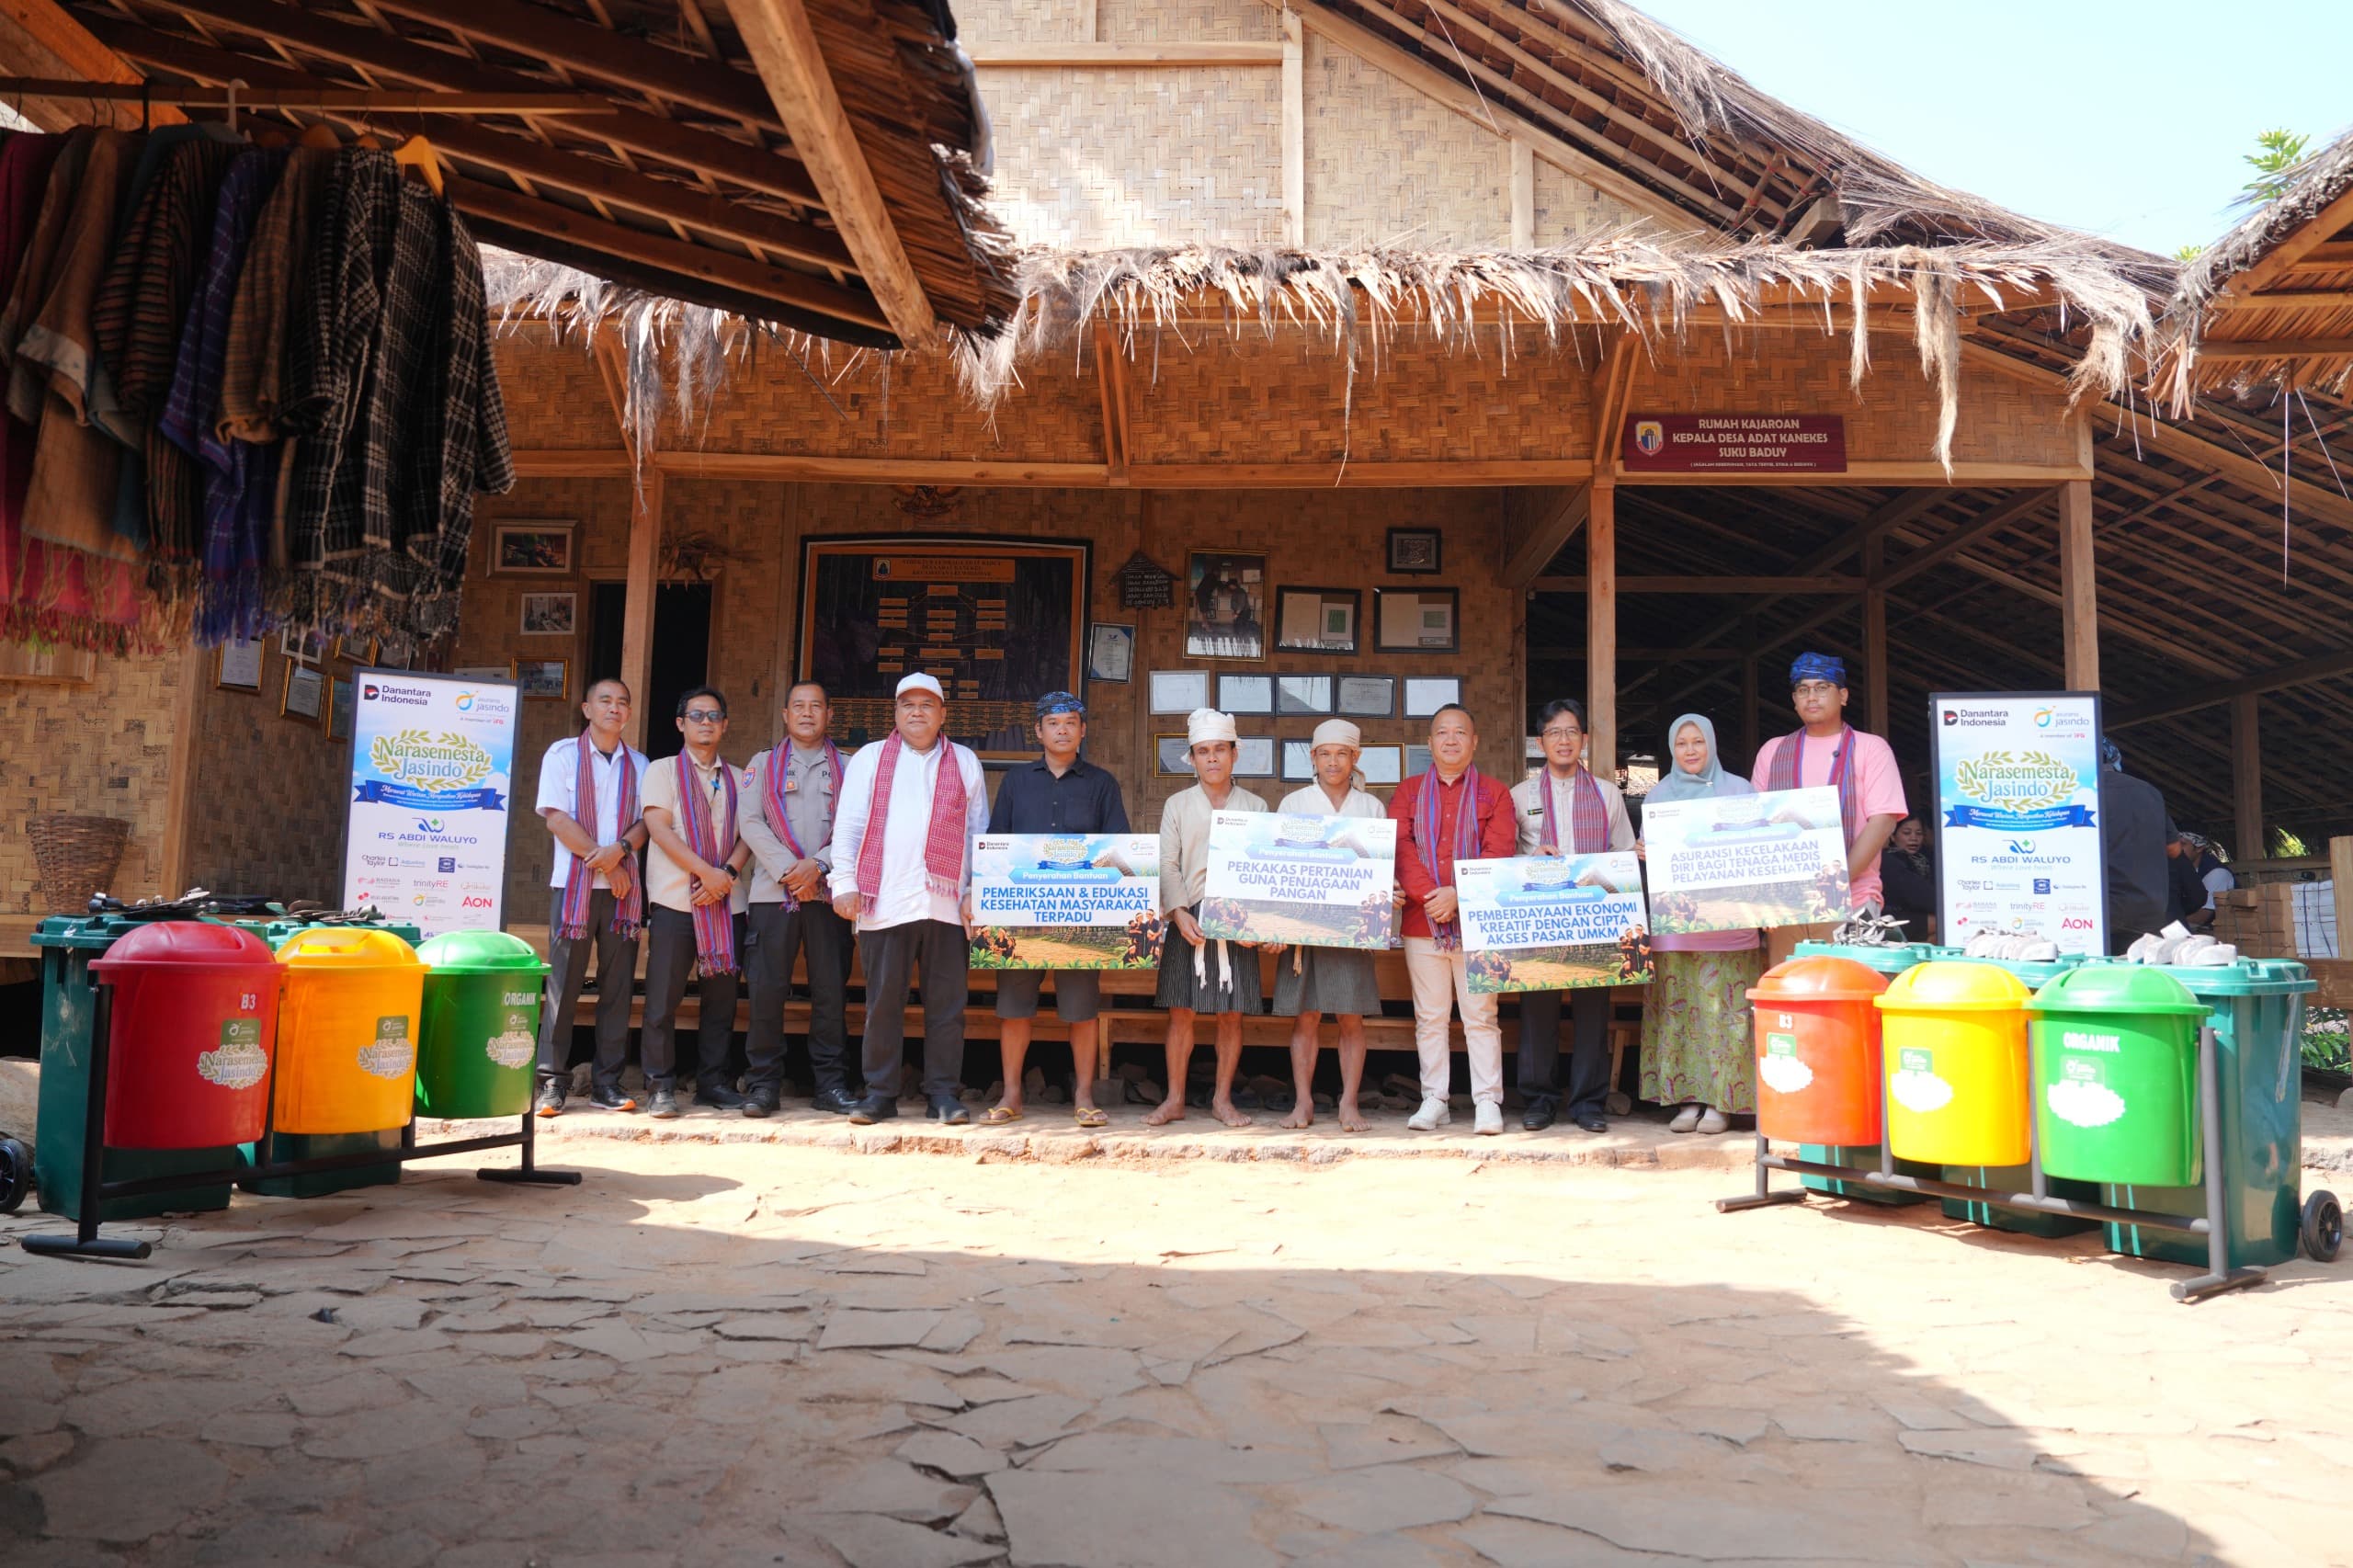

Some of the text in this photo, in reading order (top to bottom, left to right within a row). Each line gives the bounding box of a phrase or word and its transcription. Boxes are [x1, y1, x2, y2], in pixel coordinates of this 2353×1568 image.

[1699, 419, 1800, 430] RUMAH KAJAROAN
[1673, 433, 1828, 443] KEPALA DESA ADAT KANEKES
[1719, 448, 1787, 458] SUKU BADUY
[382, 685, 432, 698] Danantara
[381, 695, 428, 706] Indonesia
[476, 702, 510, 714] jasindo
[1961, 710, 2008, 718] Danantara
[1961, 718, 2006, 726] Indonesia
[2054, 717, 2090, 727] jasindo
[379, 736, 484, 763] Narasemesta
[396, 757, 462, 779] Jasindo
[1963, 761, 2070, 782] Narasemesta
[1981, 781, 2048, 802] Jasindo
[379, 832, 478, 845] RS ABDI WALUYO
[1671, 840, 1818, 862] ASURANSI KECELAKAAN
[1671, 851, 1821, 873] DIRI BAGI TENAGA MEDIS
[2022, 856, 2071, 864] WALUYO
[1022, 872, 1108, 881] Penyerahan Bantuan
[1227, 861, 1373, 880] PERKAKAS PERTANIAN
[1672, 861, 1821, 883] PELAYANAN KESEHATAN
[414, 880, 449, 890] trinityRE
[1238, 873, 1360, 890] GUNA PENJAGAAN
[983, 887, 1148, 898] PEMERIKSAAN & EDUKASI
[1269, 887, 1327, 900] PANGAN
[461, 895, 493, 908] AON
[981, 900, 1151, 911] KESEHATAN MASYARAKAT
[2010, 902, 2045, 911] trinityRE
[1034, 912, 1092, 923] TERPADU
[1468, 902, 1638, 922] PEMBERDAYAAN EKONOMI
[1480, 915, 1630, 933] KREATIF DENGAN CIPTA
[2062, 917, 2093, 929] AON
[1486, 926, 1619, 946] AKSES PASAR UMKM
[241, 993, 256, 1009] B3
[504, 992, 537, 1006] ORGANIK
[1779, 1014, 1793, 1028] B3
[2063, 1031, 2121, 1053] ORGANIK
